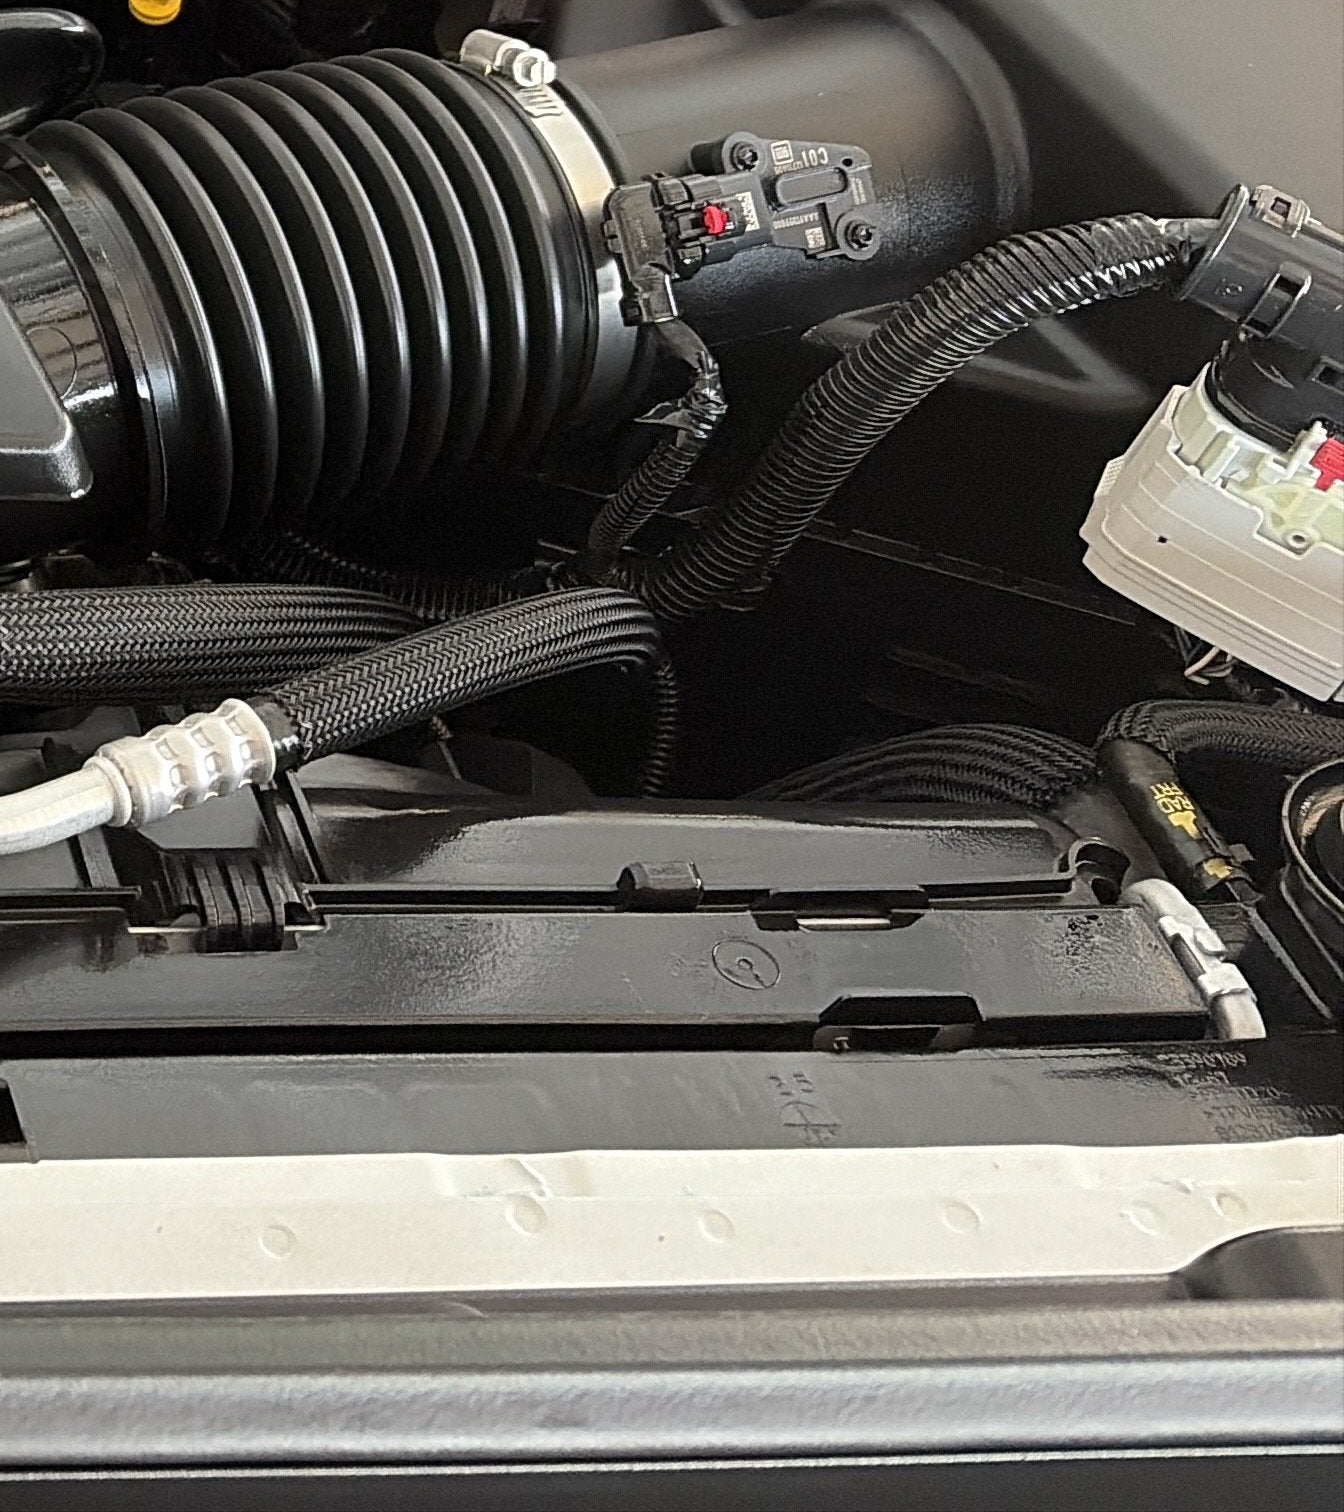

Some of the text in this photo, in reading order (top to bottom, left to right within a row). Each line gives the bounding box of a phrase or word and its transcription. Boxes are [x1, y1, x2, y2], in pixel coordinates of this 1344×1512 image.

[801, 146, 829, 168] C01
[1149, 781, 1184, 800] FRT
[1157, 794, 1195, 814] RAD
